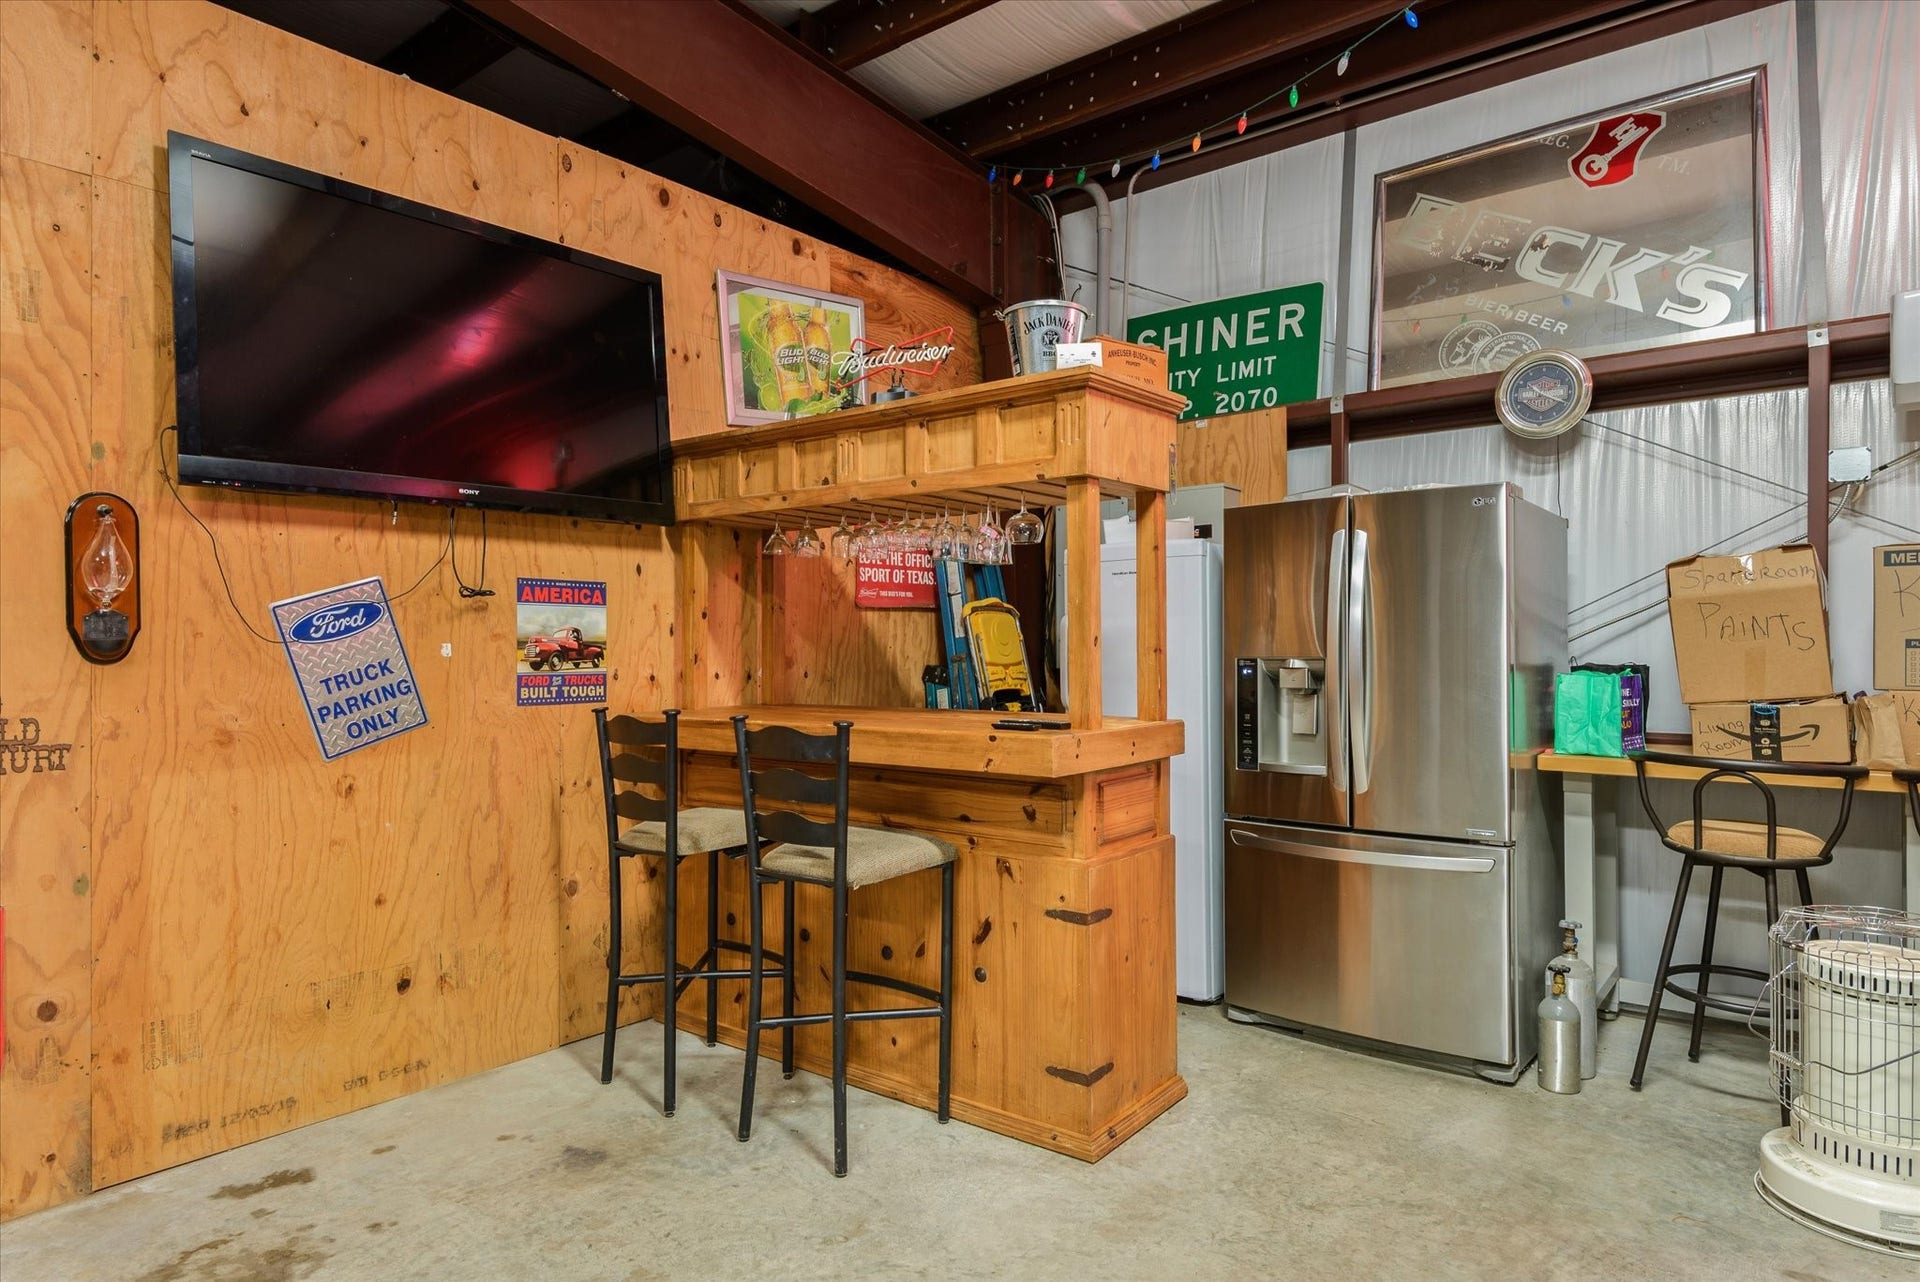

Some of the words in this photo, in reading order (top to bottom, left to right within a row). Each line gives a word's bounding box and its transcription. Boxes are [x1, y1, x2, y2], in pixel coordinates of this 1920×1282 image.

[1023, 317, 1045, 336] JACK
[1466, 294, 1509, 317] BIER
[1515, 309, 1569, 335] BEER
[1137, 303, 1305, 357] SHINER
[780, 348, 804, 357] BUD
[809, 348, 830, 360] BUD
[809, 355, 830, 366] IGHT
[831, 343, 955, 376] Budweiser
[1169, 367, 1202, 390] ITY
[1216, 355, 1278, 383] LIMIT
[1178, 399, 1200, 420] P.
[1215, 387, 1278, 415] 2070
[886, 551, 904, 567] THE
[859, 567, 891, 583] SPORT
[893, 569, 905, 584] OF
[906, 570, 937, 586] TEXAS.
[521, 586, 604, 605] AMERICA
[310, 607, 366, 638] Ford
[320, 658, 395, 695] TRUCK
[521, 676, 550, 687] FORD
[564, 674, 604, 686] TRUCKS
[317, 679, 413, 724] PARKING
[520, 686, 559, 699] BUILT
[562, 685, 605, 697] TOUGH
[0, 718, 40, 746] LD
[346, 707, 399, 739] ONLY
